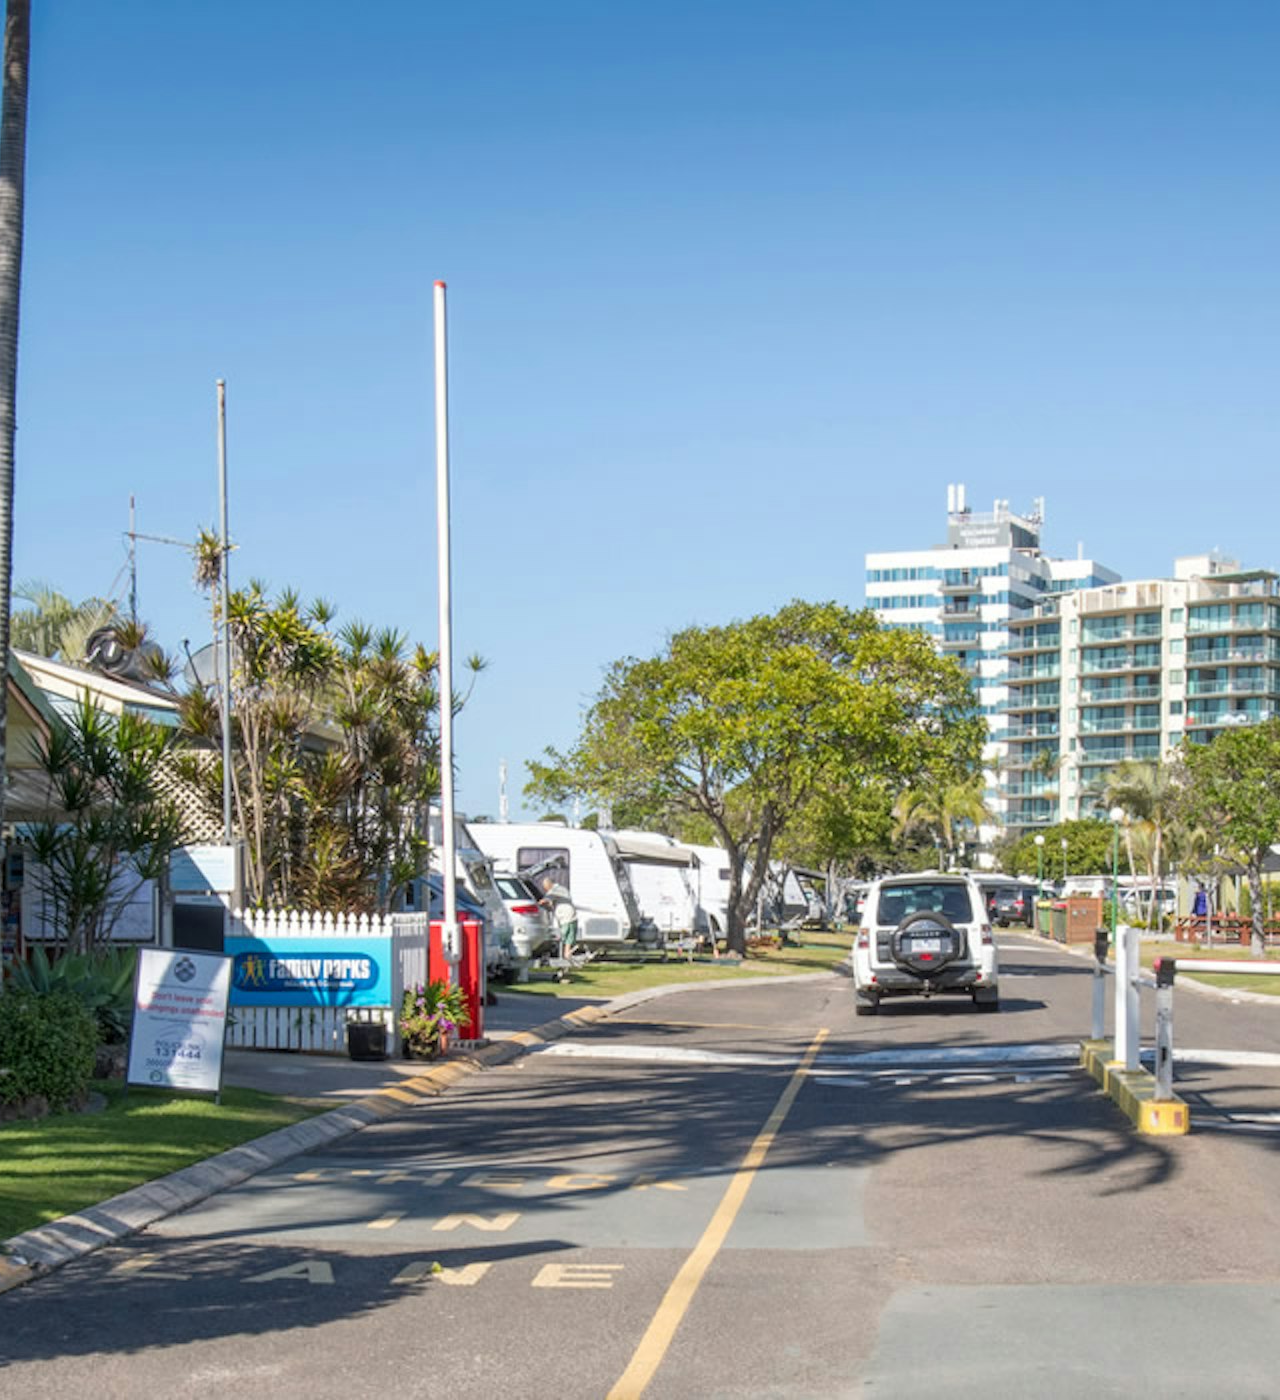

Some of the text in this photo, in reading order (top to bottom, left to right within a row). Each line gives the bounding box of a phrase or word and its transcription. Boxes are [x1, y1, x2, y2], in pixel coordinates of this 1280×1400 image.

[269, 957, 371, 980] family parks
[290, 1167, 689, 1192] CHECK
[367, 1211, 520, 1232] IN
[105, 1252, 625, 1289] LANE
